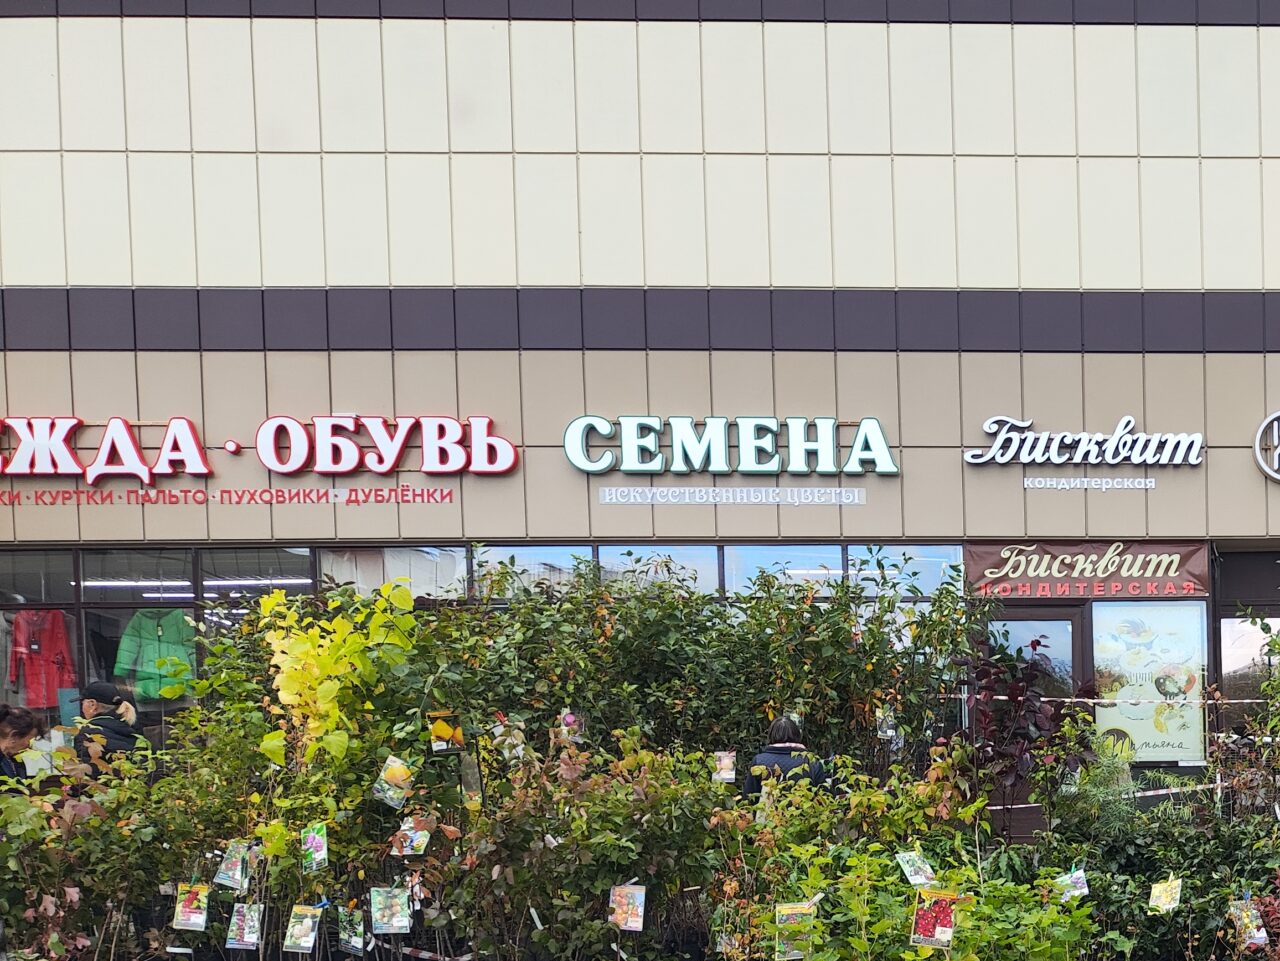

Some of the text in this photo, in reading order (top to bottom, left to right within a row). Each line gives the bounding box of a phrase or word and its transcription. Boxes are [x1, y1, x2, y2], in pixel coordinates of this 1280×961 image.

[0, 416, 518, 486] ЖДА ОБУВЬ
[563, 415, 900, 475] СЕМЕНА
[963, 415, 1203, 465] Бисквит
[34, 490, 114, 506] КУРТКИ
[127, 489, 208, 505] ПАЛЬТО
[219, 489, 330, 505] ПУХОВИКИ
[345, 483, 454, 506] ДУБЛЁНКИ
[1023, 477, 1156, 491] кондитерская
[984, 542, 1181, 578] Бисквит
[981, 581, 1196, 597] КОНДИТЕРСКАЯ
